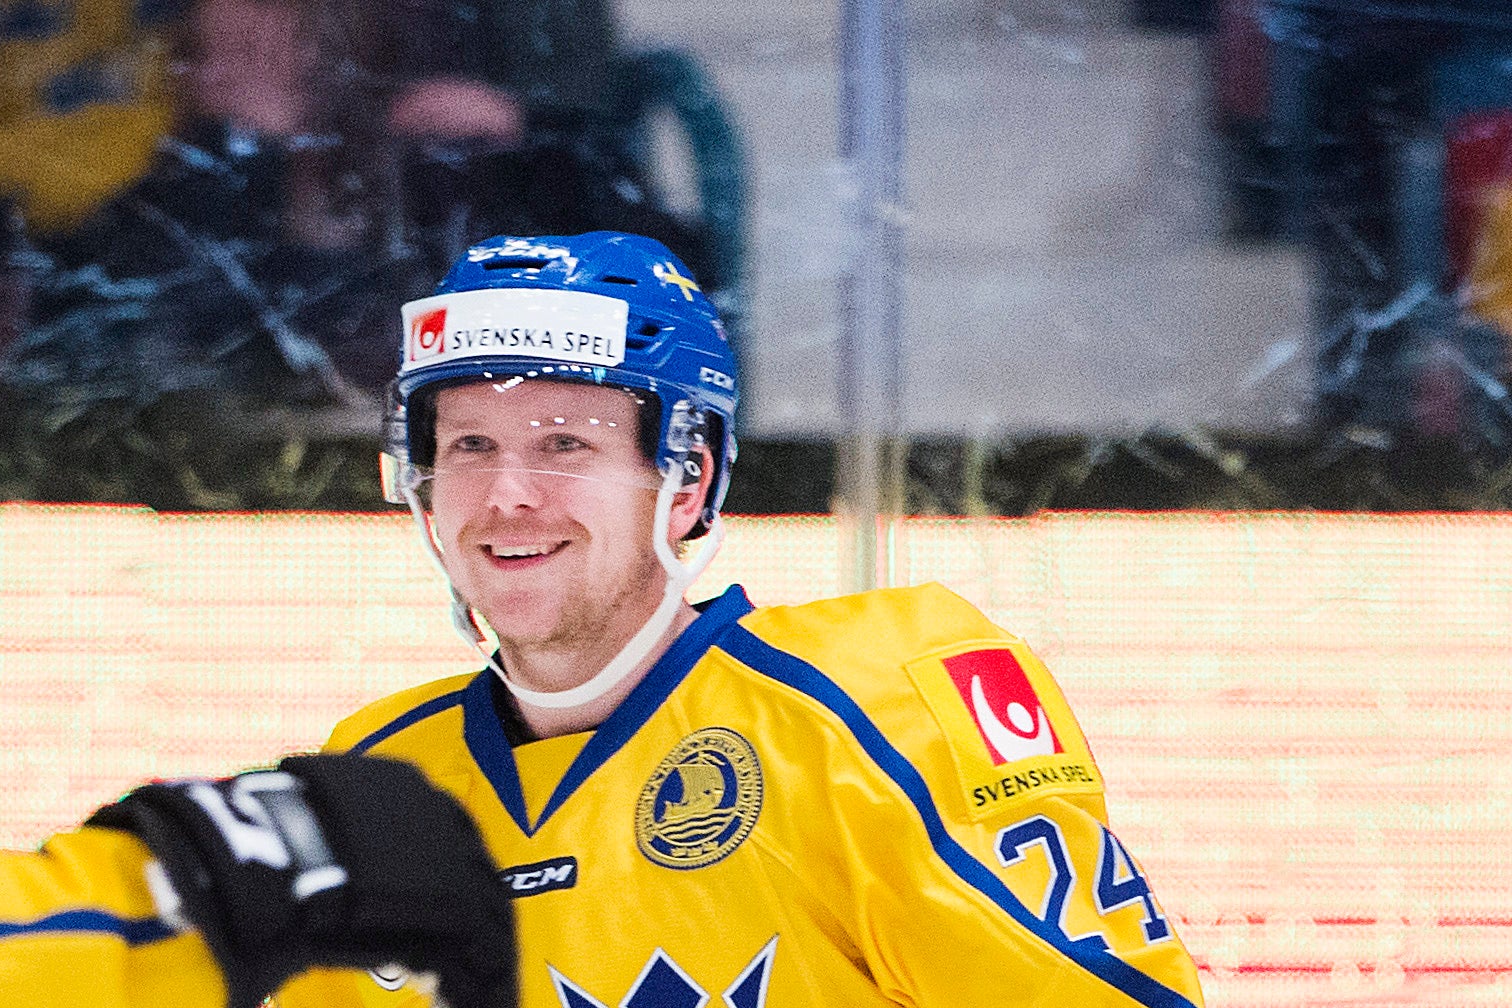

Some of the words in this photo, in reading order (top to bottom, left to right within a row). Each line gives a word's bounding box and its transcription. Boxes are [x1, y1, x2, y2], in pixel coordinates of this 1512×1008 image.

[452, 327, 555, 351] SVENSKA
[563, 331, 616, 359] SPEL
[973, 768, 1060, 807] SVENSKA
[1061, 765, 1094, 783] SPEL
[503, 864, 574, 890] CM
[994, 813, 1174, 955] 24
